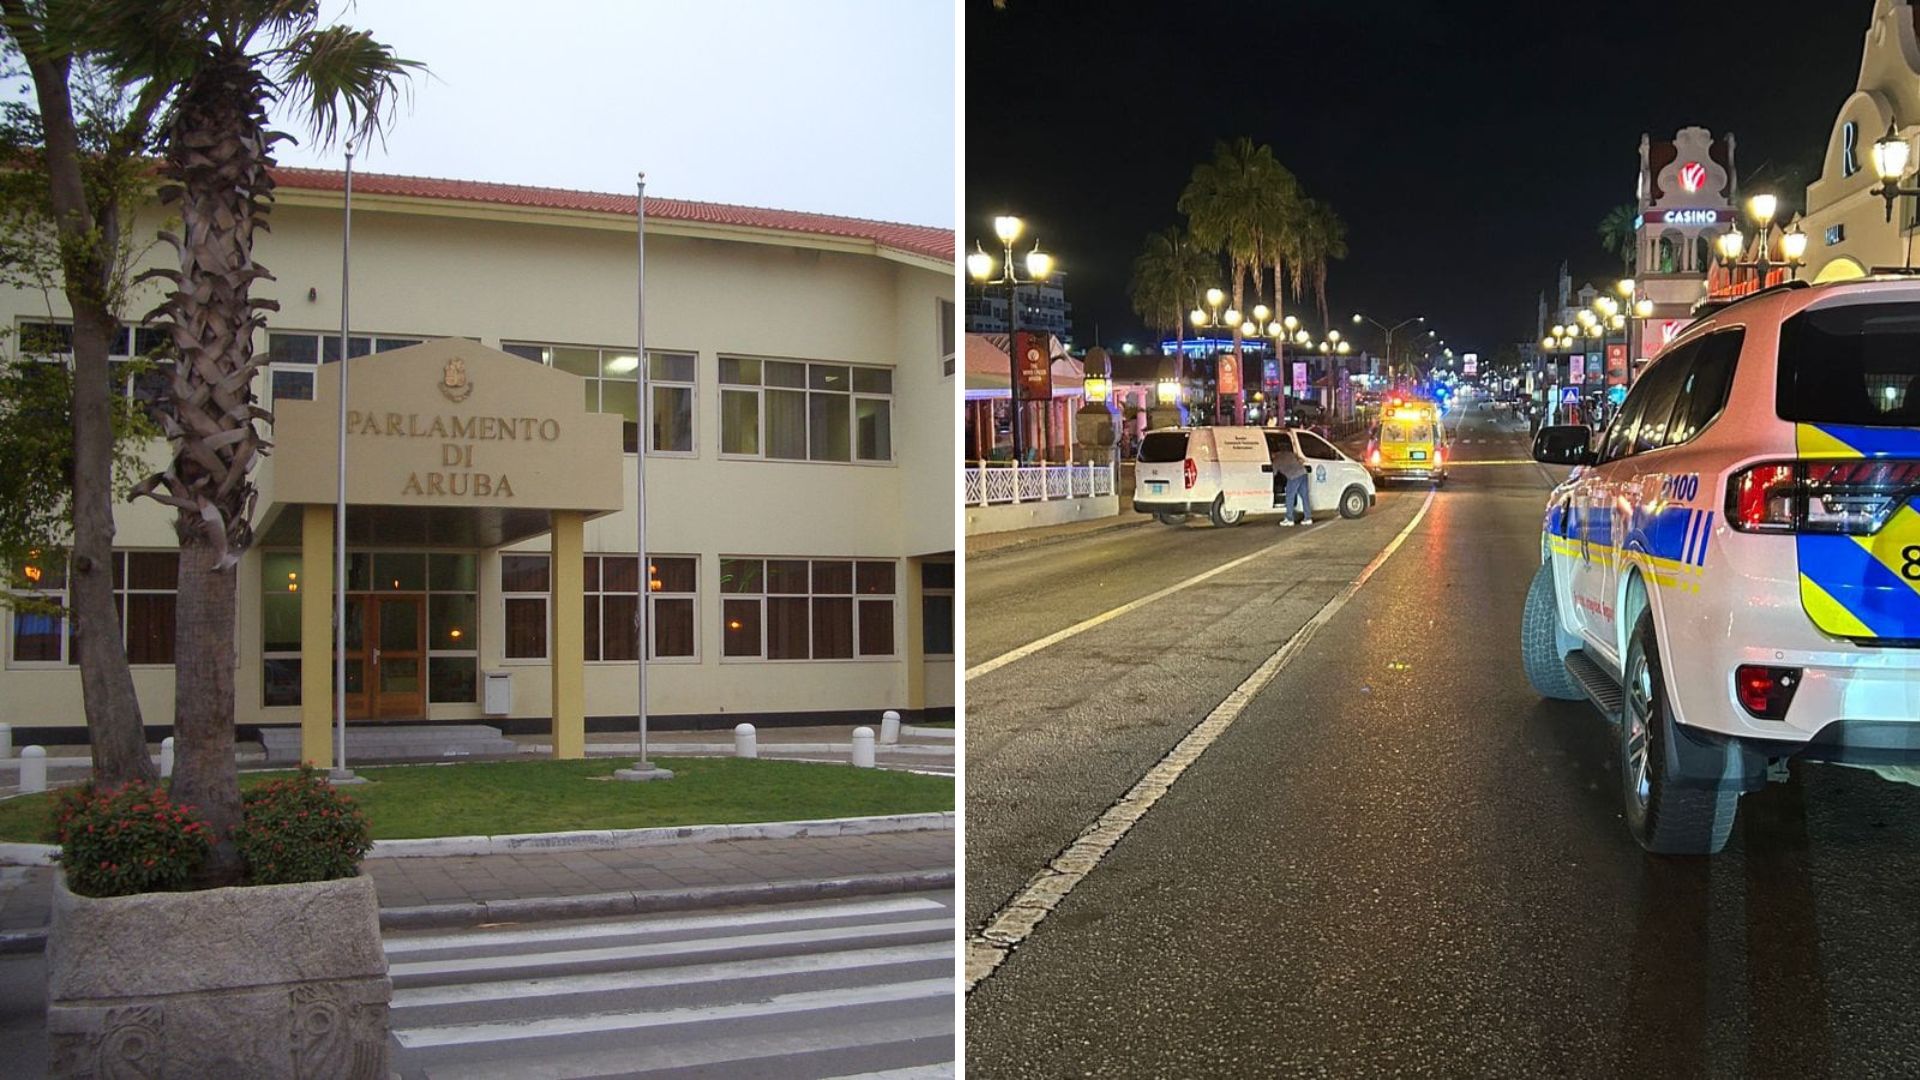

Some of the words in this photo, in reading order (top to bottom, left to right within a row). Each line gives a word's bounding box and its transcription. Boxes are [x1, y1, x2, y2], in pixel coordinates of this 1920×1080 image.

[1843, 121, 1858, 178] R
[1664, 210, 1717, 223] CASINO
[346, 410, 560, 442] PARLAMENTO
[442, 443, 474, 468] DI
[402, 471, 515, 498] ARUBA
